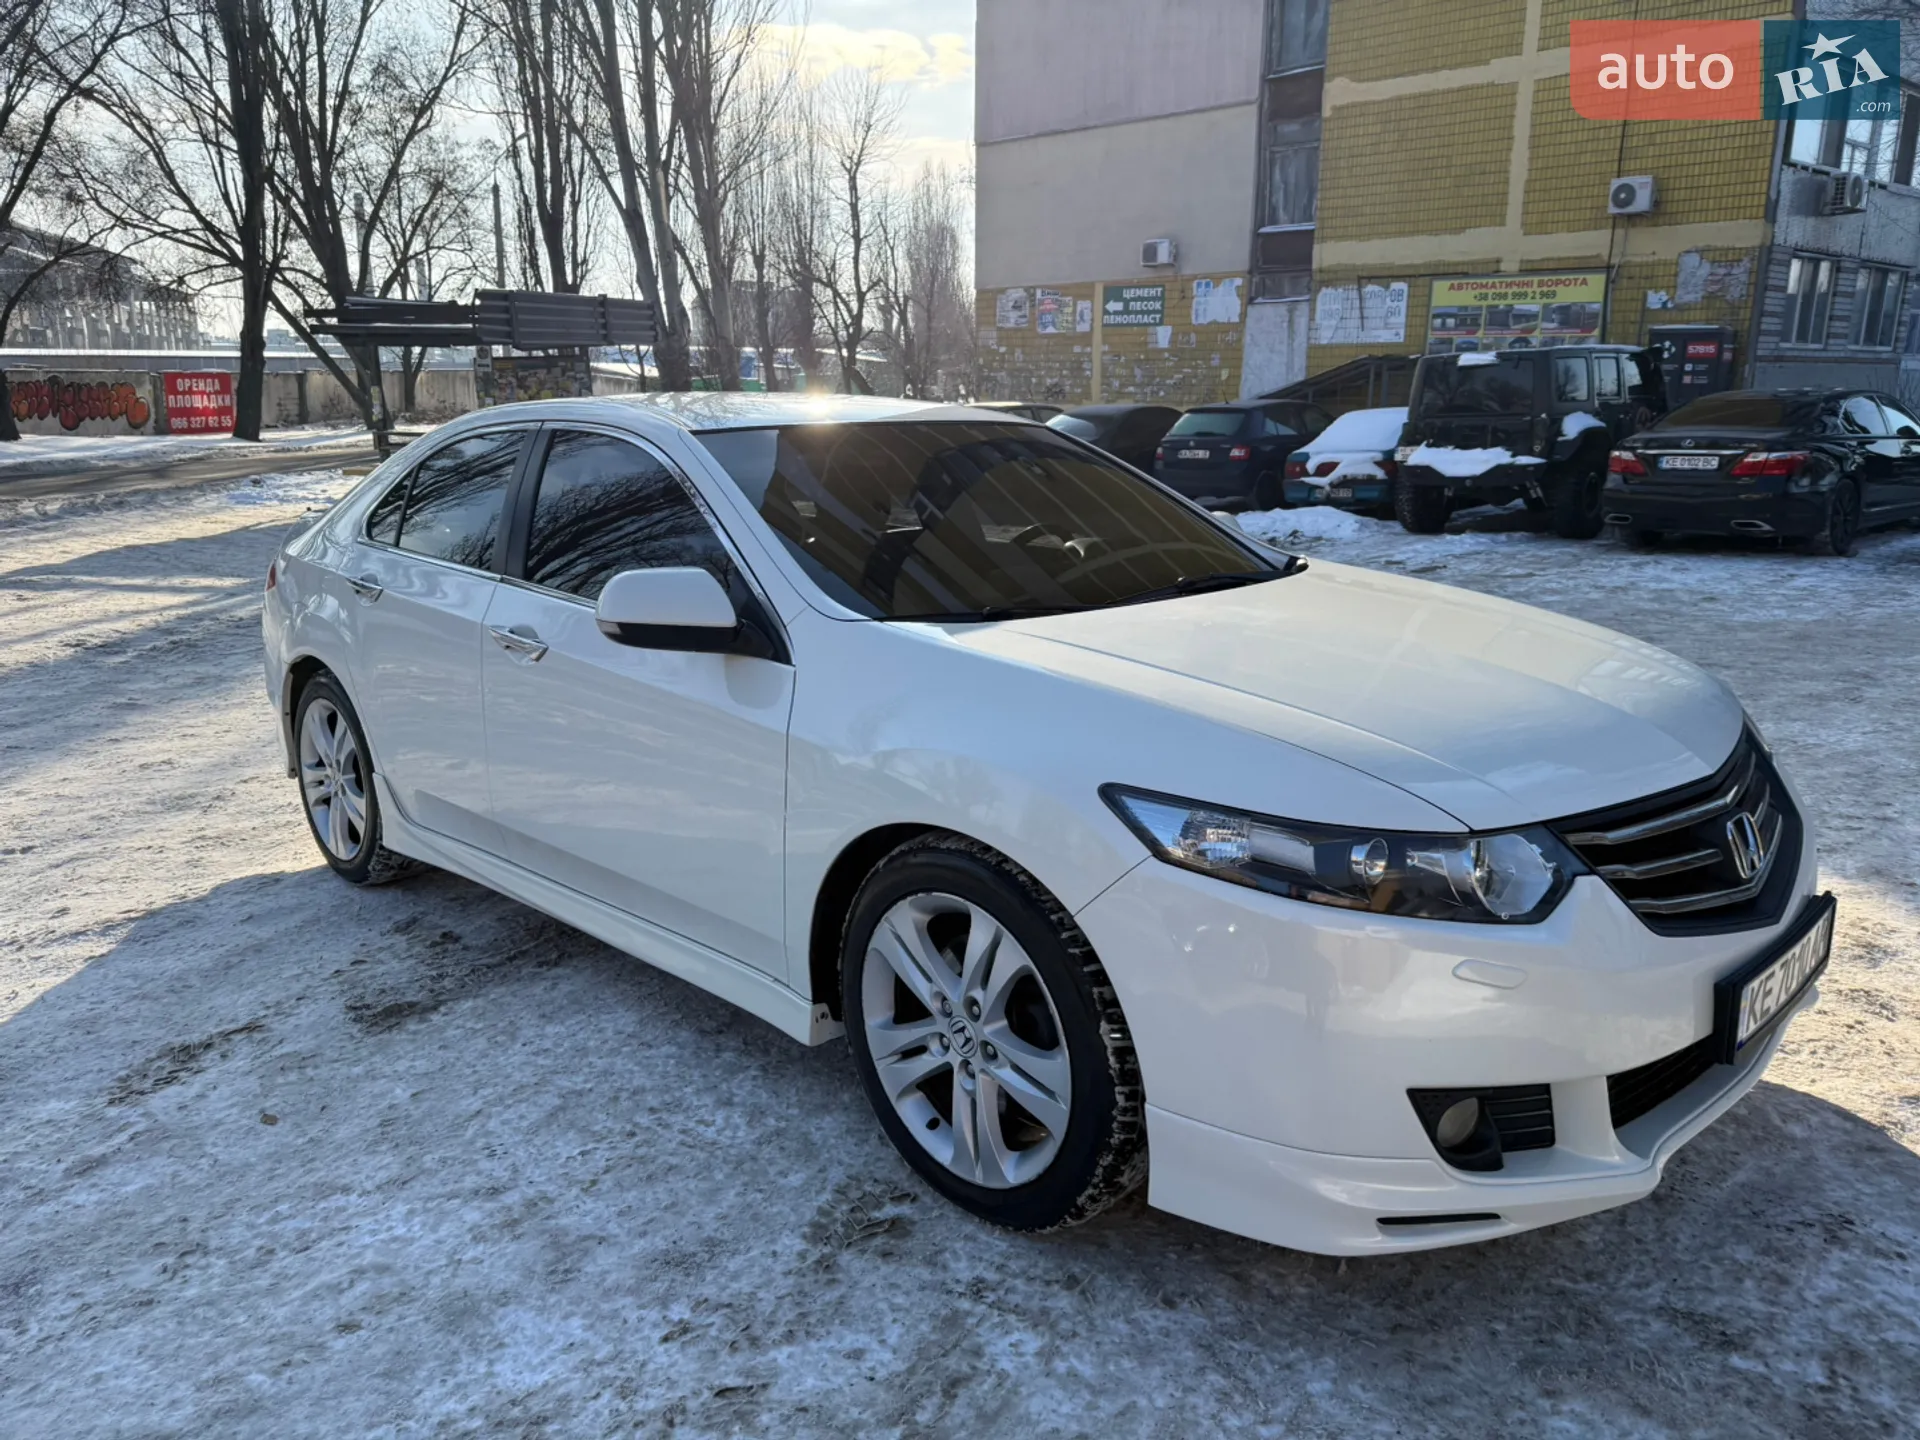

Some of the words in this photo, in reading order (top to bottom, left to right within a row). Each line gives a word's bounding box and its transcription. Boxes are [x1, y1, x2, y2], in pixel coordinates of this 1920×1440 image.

[1447, 279, 1534, 292] АВТОМАТИЧНІ
[1537, 277, 1589, 288] ВОРОТА
[1122, 287, 1163, 299] ЦЕМЕНТ
[1473, 292, 1489, 302] +38
[1511, 290, 1528, 300] 999
[1531, 290, 1537, 299] 2
[1129, 301, 1162, 311] ПЕСОК
[1103, 314, 1161, 324] ПЕНОПЛАСТ
[176, 378, 221, 392] ОРЕНДА
[168, 395, 231, 409] ПЛОЩАДКИ
[190, 416, 205, 428] 327
[221, 415, 232, 427] 55
[1664, 458, 1678, 467] KE
[1680, 458, 1700, 467] 0102
[1702, 458, 1717, 467] BC
[1746, 967, 1775, 1033] KE
